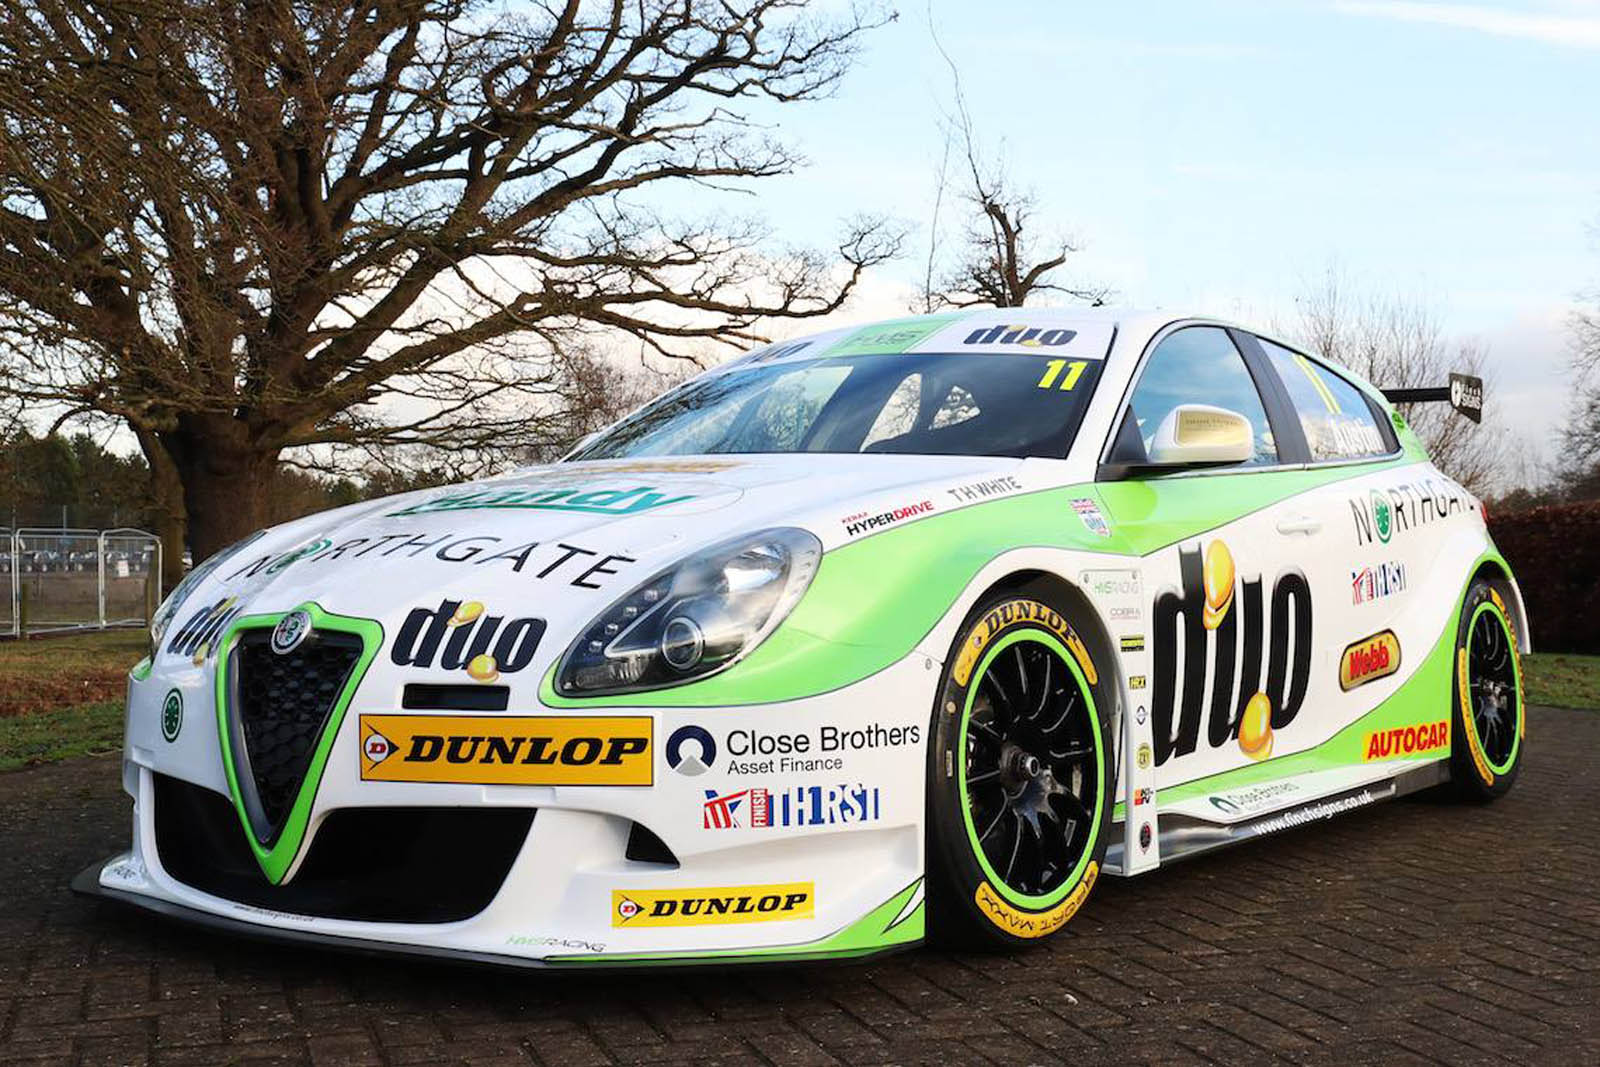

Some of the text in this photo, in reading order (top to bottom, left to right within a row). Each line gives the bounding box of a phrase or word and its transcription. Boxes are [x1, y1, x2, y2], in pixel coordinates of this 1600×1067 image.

[963, 325, 1078, 346] duo
[1038, 359, 1088, 391] 11
[971, 476, 1022, 497] WHITE
[846, 500, 934, 537] HYPERDRIVE
[225, 533, 636, 590] NORTHGATE
[391, 598, 547, 677] duo
[984, 601, 1078, 643] DUNLOP
[1152, 539, 1314, 768] duo
[1349, 636, 1390, 682] Webb
[403, 735, 648, 766] DUNLOP
[727, 723, 920, 756] Close Brothers
[1367, 722, 1448, 760] AUTOCAR
[727, 757, 843, 775] Asset Finance
[1251, 789, 1375, 836] www.finchsigns.co.uk
[649, 893, 807, 917] DUNLOP
